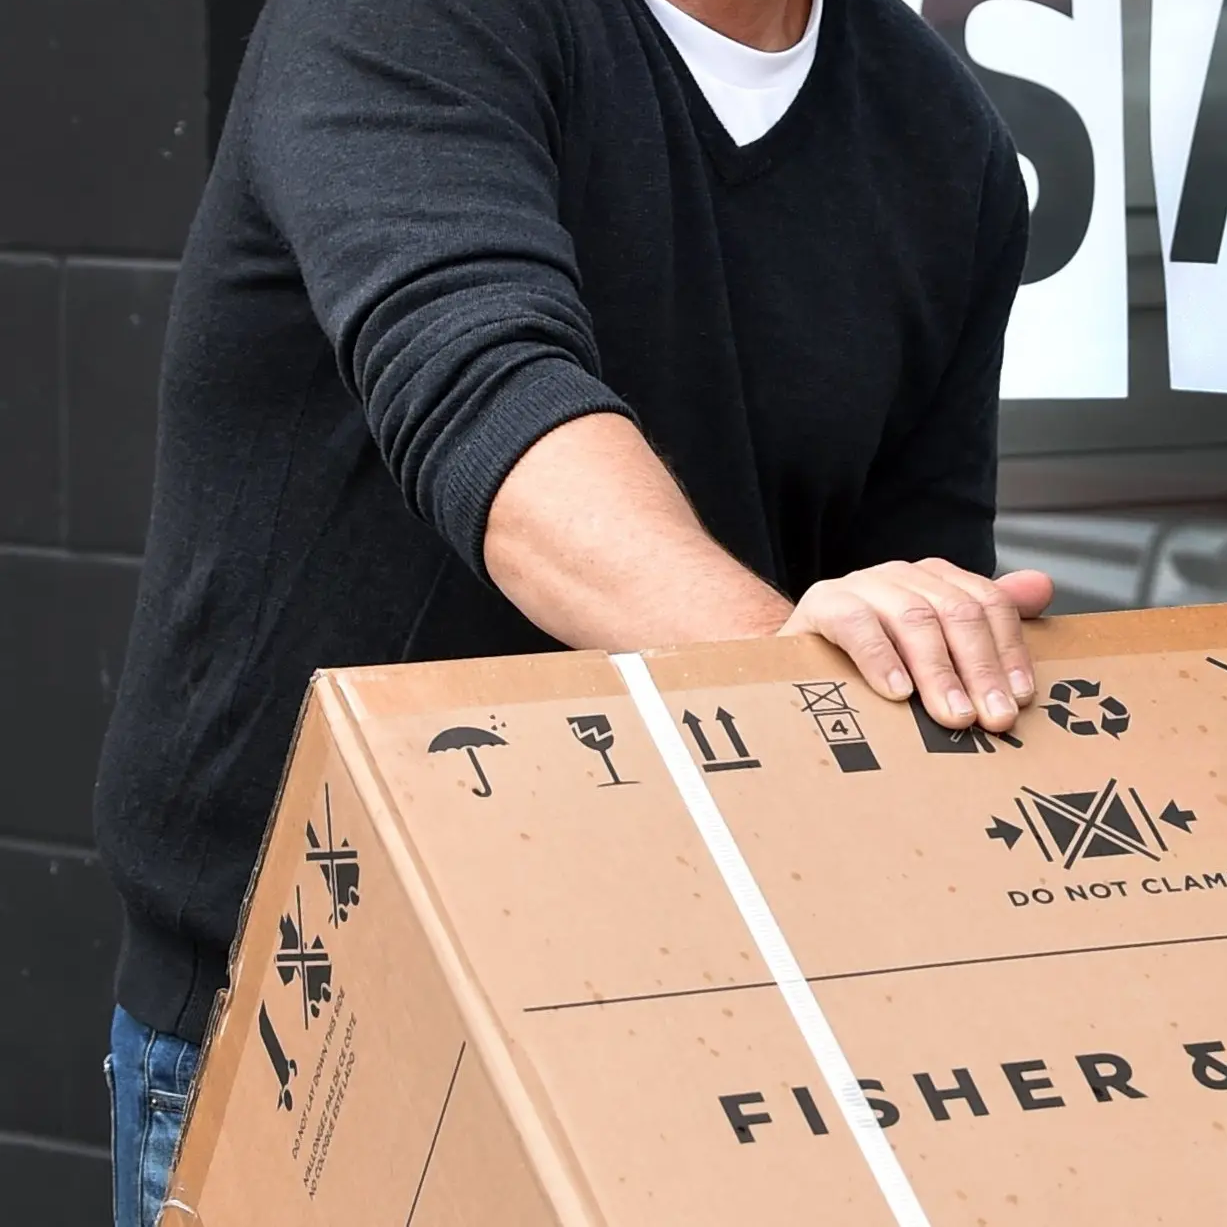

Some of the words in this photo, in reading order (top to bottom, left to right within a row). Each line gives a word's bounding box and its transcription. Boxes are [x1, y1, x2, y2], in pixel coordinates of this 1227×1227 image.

[831, 719, 849, 736] 4
[1007, 887, 1055, 907] DO
[1064, 880, 1128, 901] NOT
[718, 1051, 1148, 1145] FISHER
